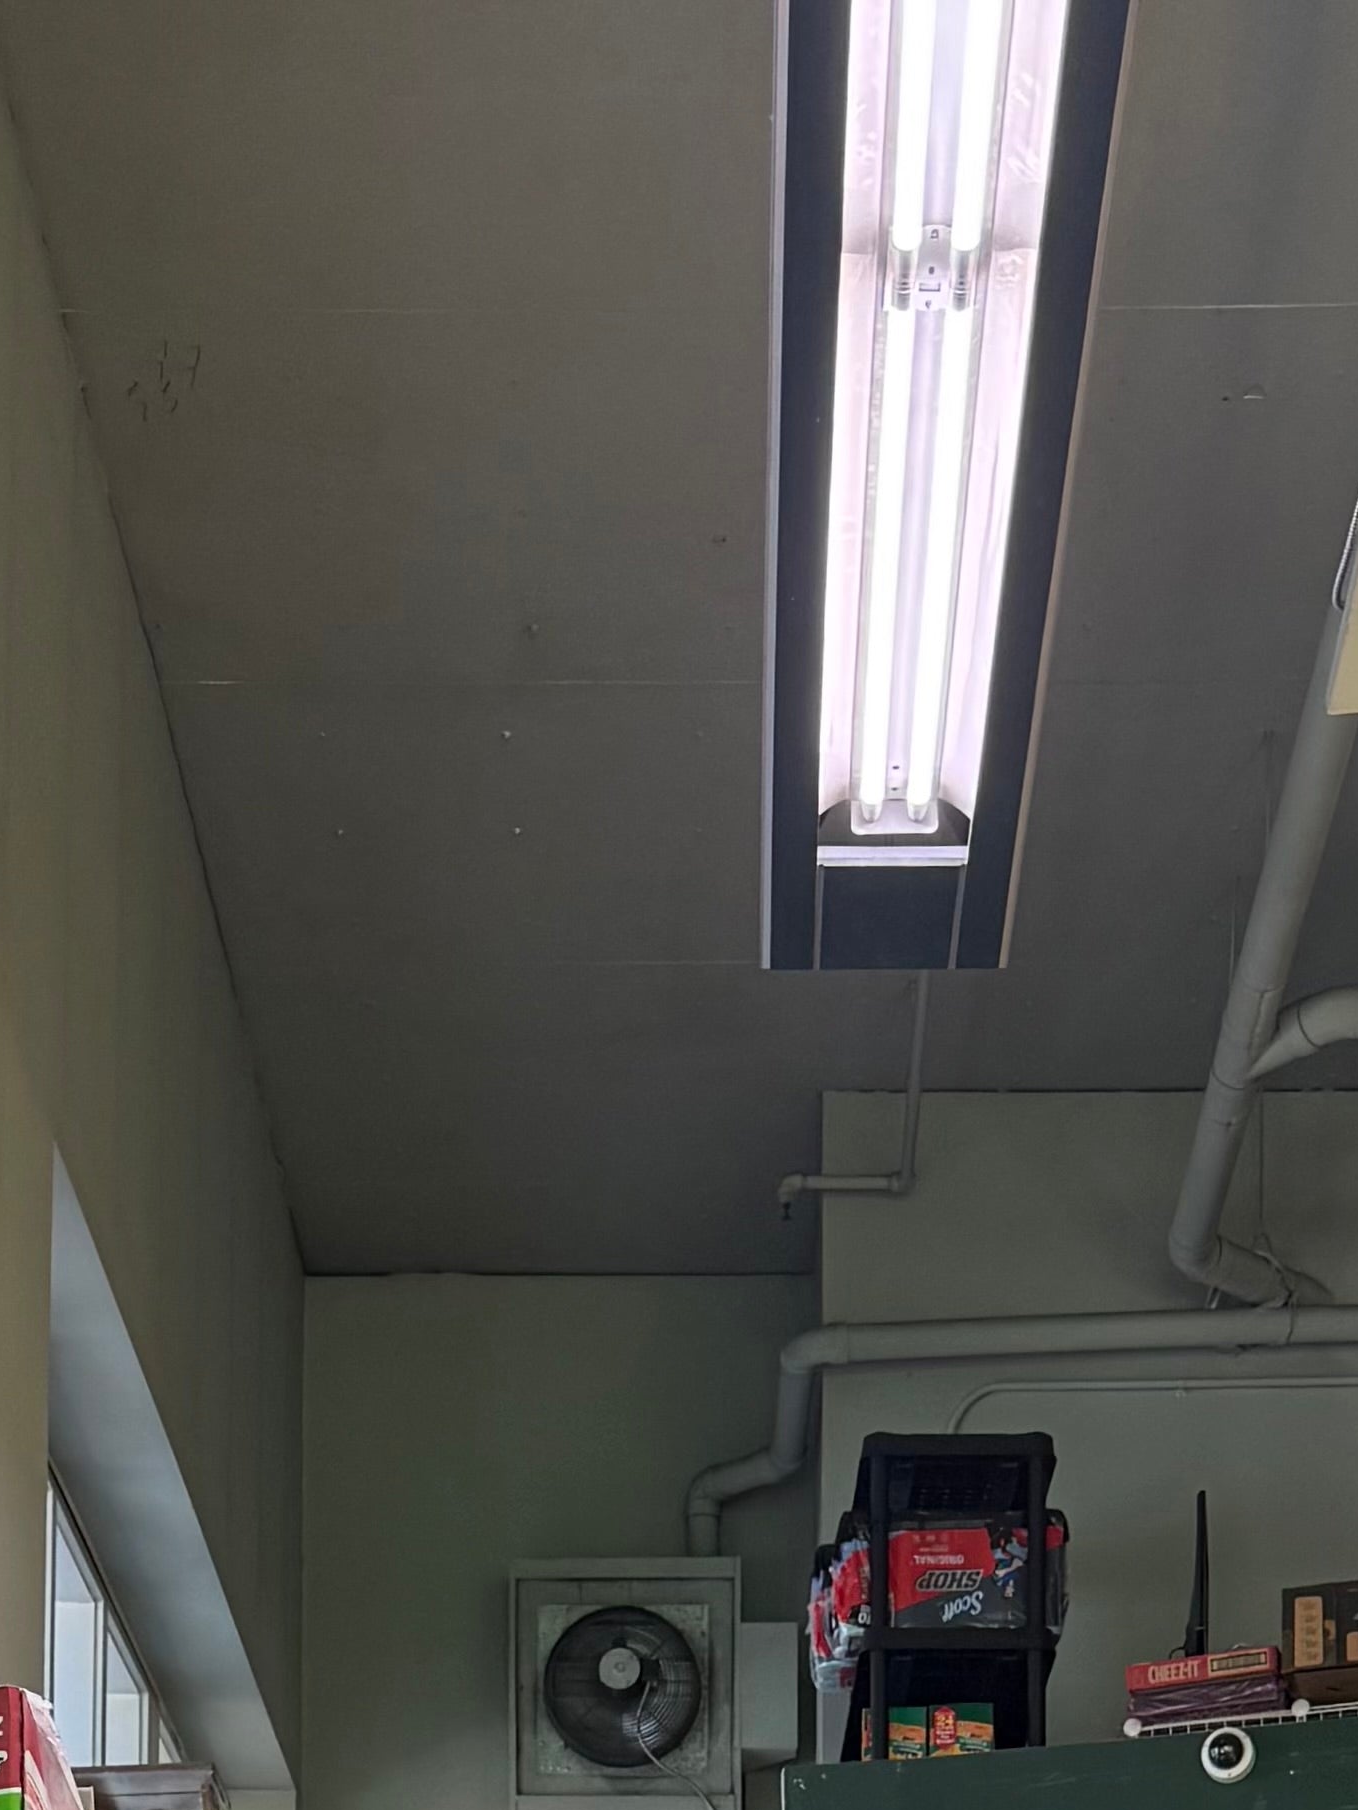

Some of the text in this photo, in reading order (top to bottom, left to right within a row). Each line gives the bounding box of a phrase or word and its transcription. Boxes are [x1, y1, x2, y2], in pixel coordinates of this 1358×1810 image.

[913, 1554, 964, 1565] ORIGINAL
[915, 1569, 983, 1592] SHOP
[942, 1591, 983, 1622] Scott
[1147, 1660, 1199, 1684] CHEEZ-IT
